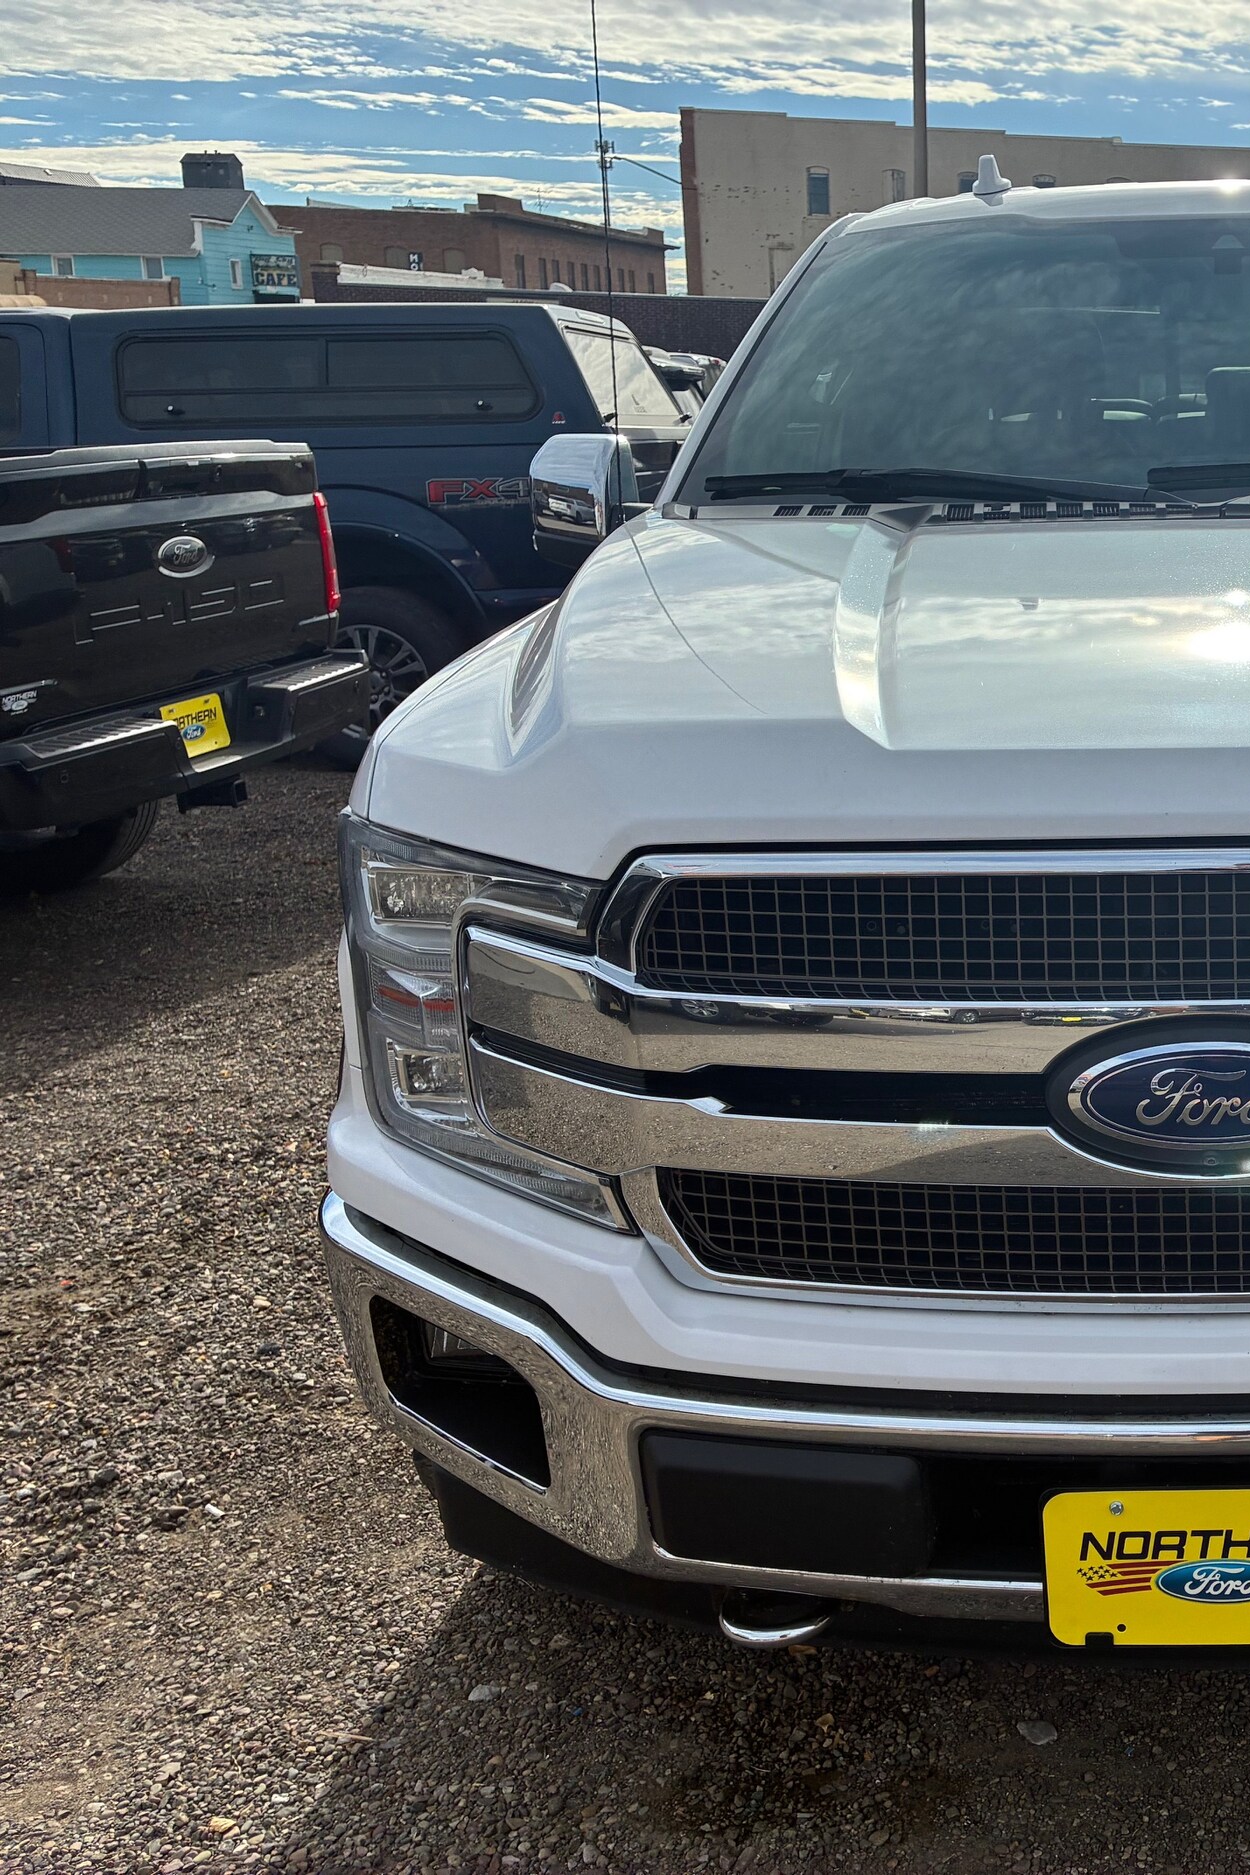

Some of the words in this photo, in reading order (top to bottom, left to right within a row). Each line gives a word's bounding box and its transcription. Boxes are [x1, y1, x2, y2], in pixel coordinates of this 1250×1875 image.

[254, 272, 297, 286] CAFE
[426, 477, 531, 505] FX4
[173, 544, 200, 565] Ford
[173, 706, 217, 731] RTHERN
